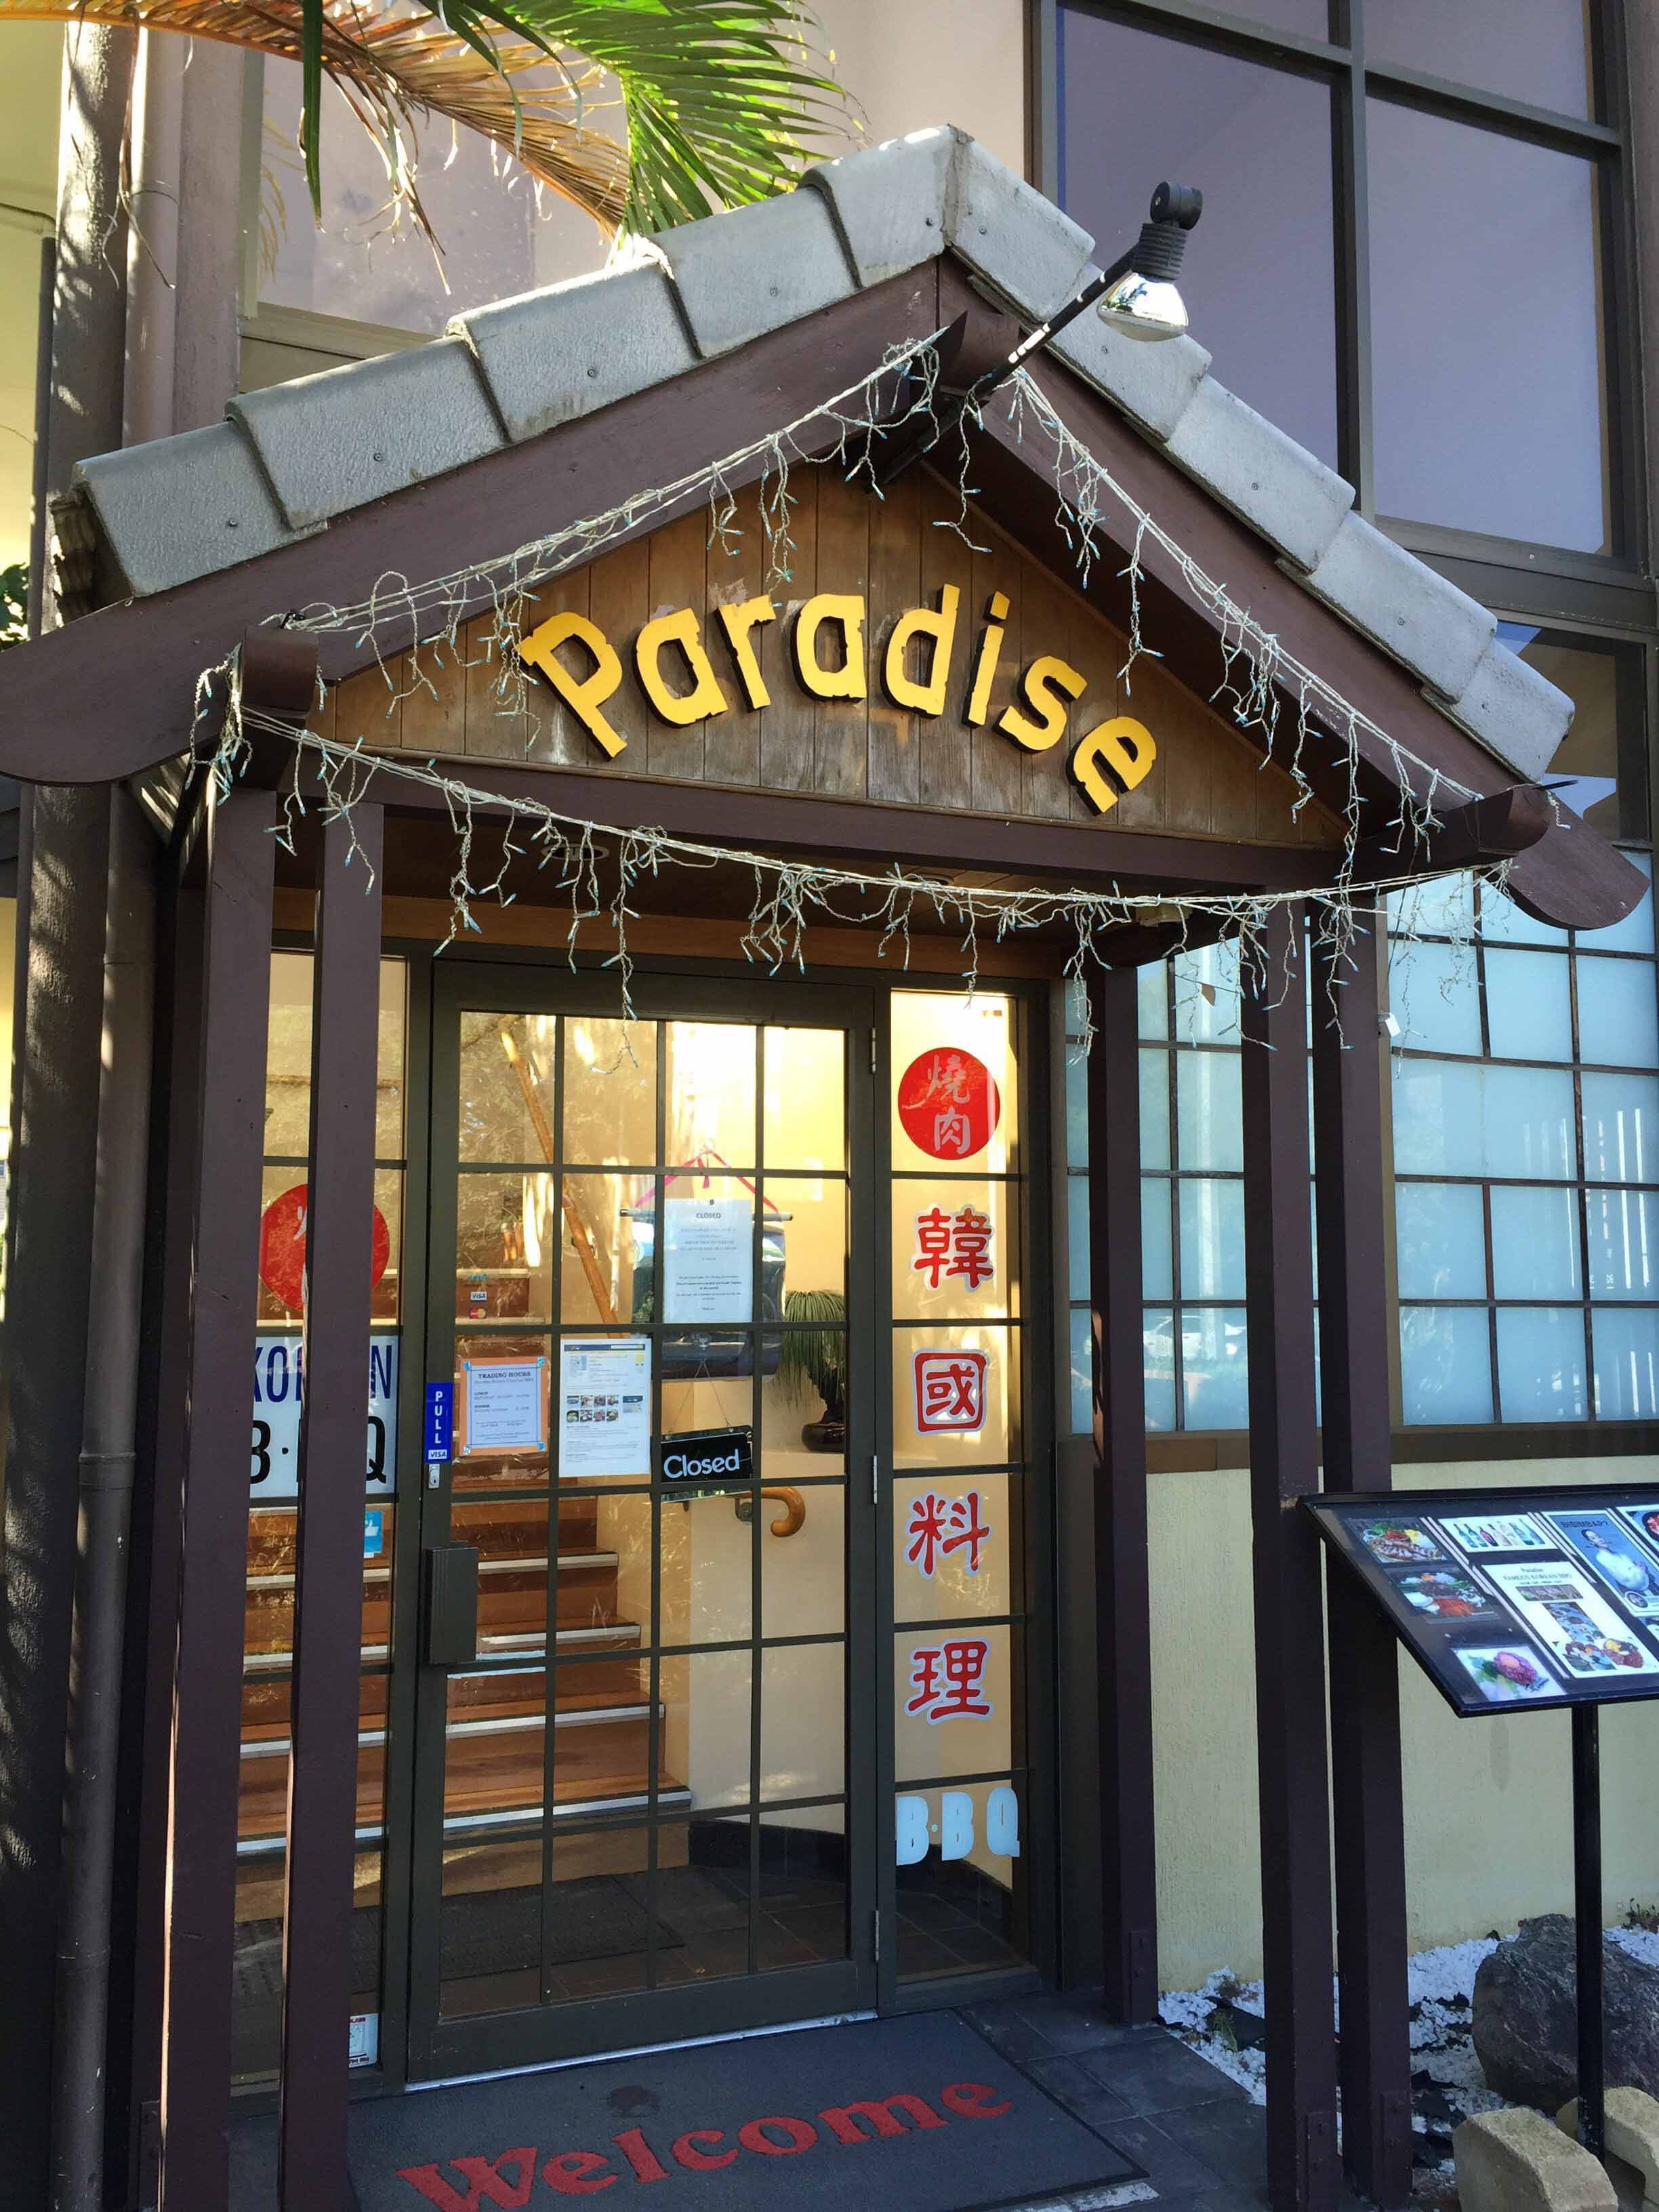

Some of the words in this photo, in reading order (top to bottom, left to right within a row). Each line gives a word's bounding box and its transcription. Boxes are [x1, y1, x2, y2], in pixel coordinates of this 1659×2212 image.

[515, 583, 1158, 815] Paradise
[434, 1391, 443, 1444] PULL
[430, 1450, 447, 1458] VISA
[663, 1448, 741, 1479] Closed
[394, 2081, 1012, 2212] Welcome
